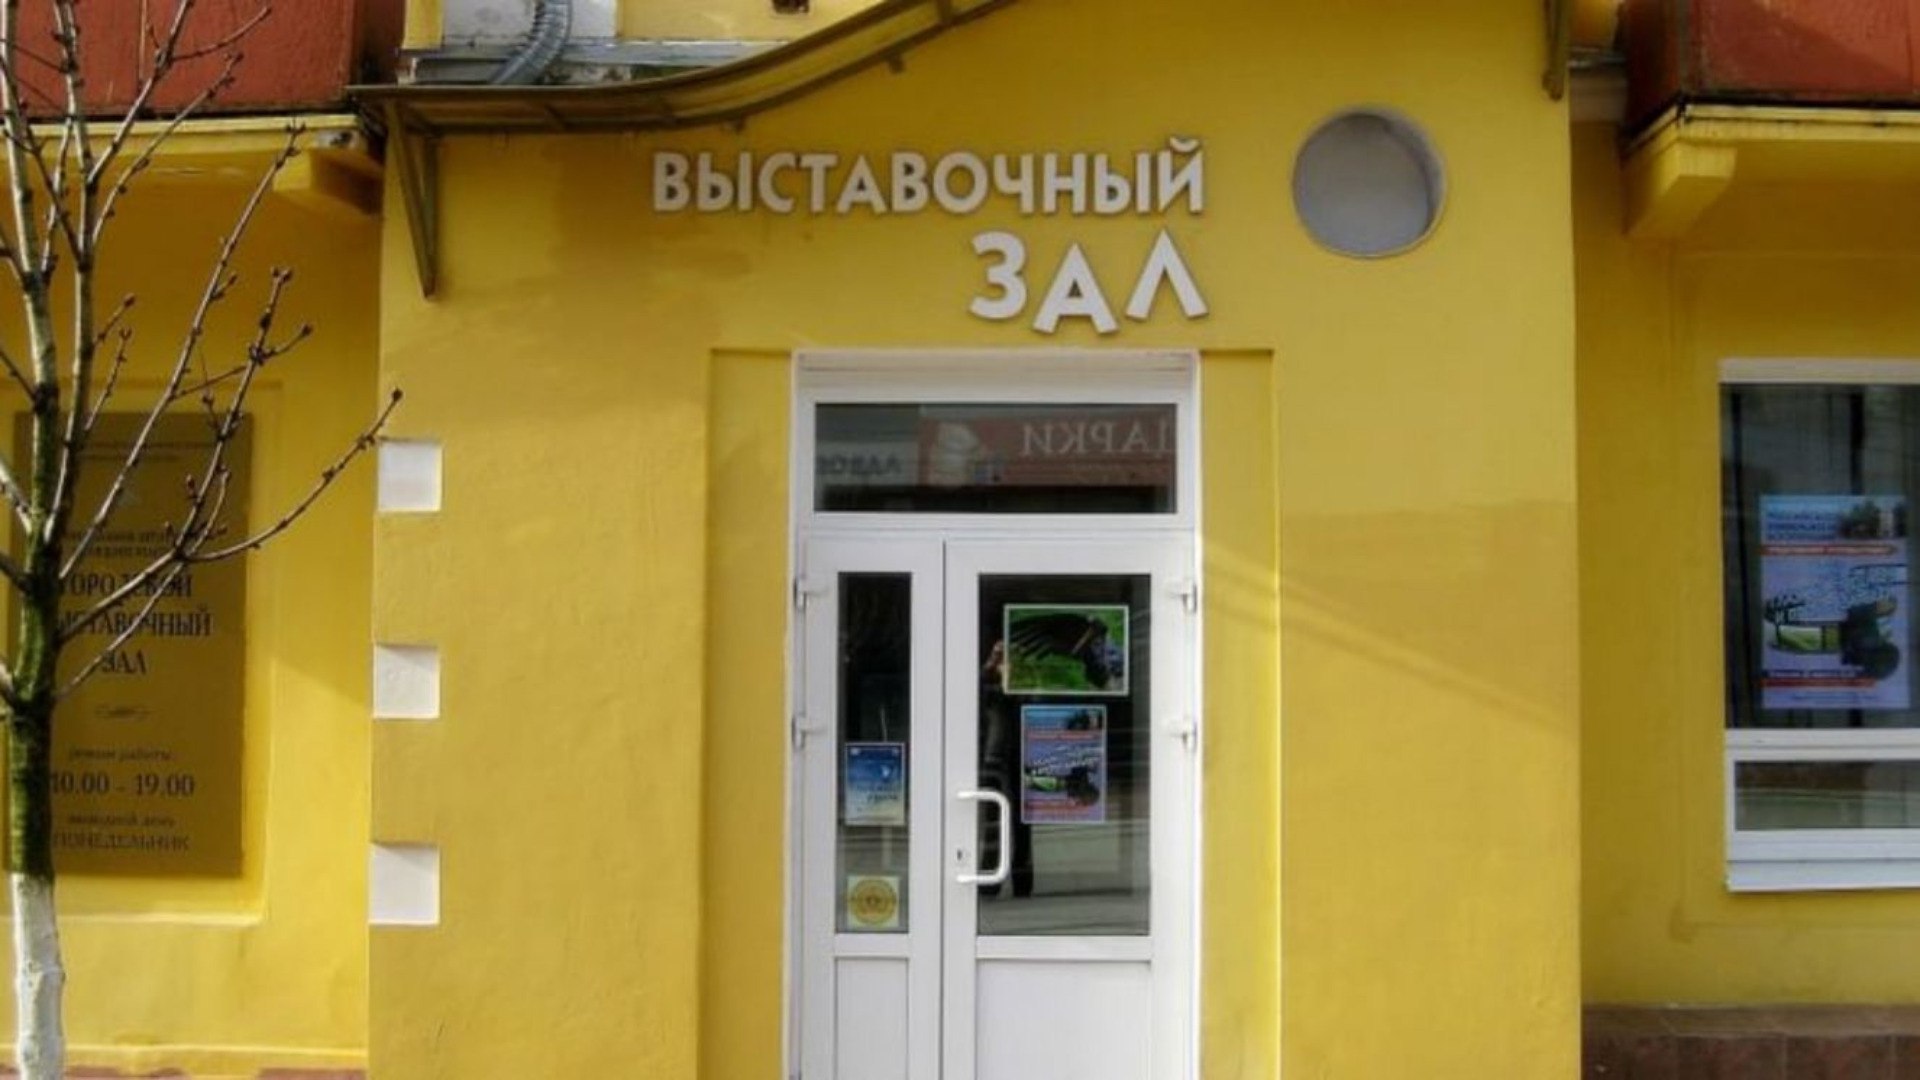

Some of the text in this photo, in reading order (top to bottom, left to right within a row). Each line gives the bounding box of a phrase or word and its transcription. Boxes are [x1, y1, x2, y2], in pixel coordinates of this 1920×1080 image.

[651, 136, 1205, 216] ВЫСТАВОЧНЫЙ
[968, 229, 1209, 334] ЗАЛ
[58, 572, 192, 598] ОРОСКОЙ
[56, 603, 211, 637] ЫСТАВОЧНЫЙ
[101, 648, 147, 675] ЗАЛ
[50, 771, 109, 795] 10.00
[134, 772, 195, 796] 19.00
